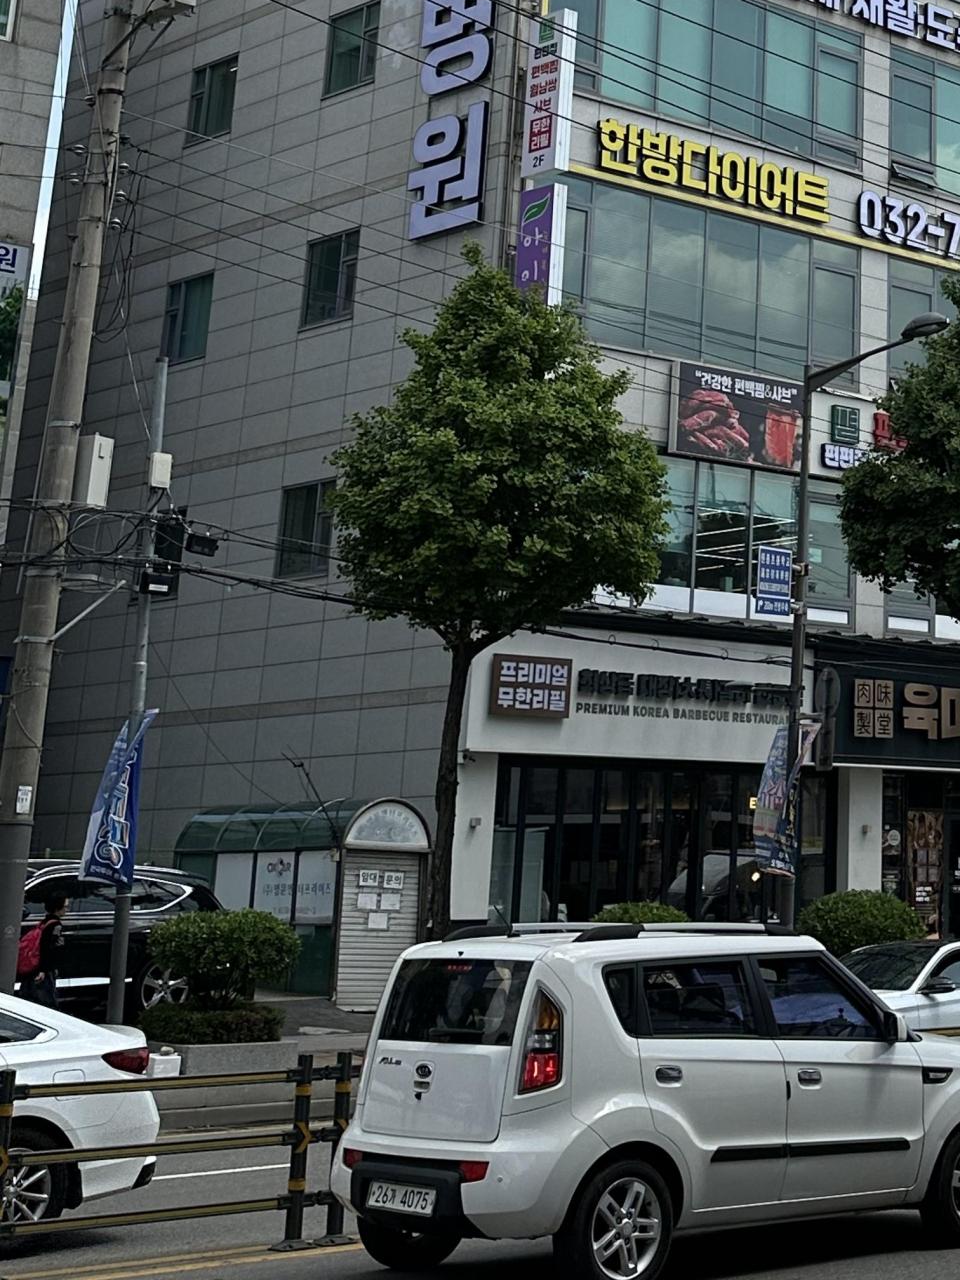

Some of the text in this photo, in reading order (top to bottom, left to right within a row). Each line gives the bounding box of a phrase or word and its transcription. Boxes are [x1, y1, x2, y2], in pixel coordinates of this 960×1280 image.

[532, 116, 550, 132] 무한
[531, 132, 550, 150] 리필
[532, 154, 545, 169] 2F
[596, 117, 830, 223] 한방다이어트
[501, 660, 569, 687] 프리미엄
[497, 686, 566, 712] 무한리필
[855, 679, 894, 709] 肉味
[575, 702, 790, 727] PREMIUM KOREA BARBECUE RESTAURA
[361, 872, 402, 887] 임대 문의
[400, 1189, 430, 1211] 4075
